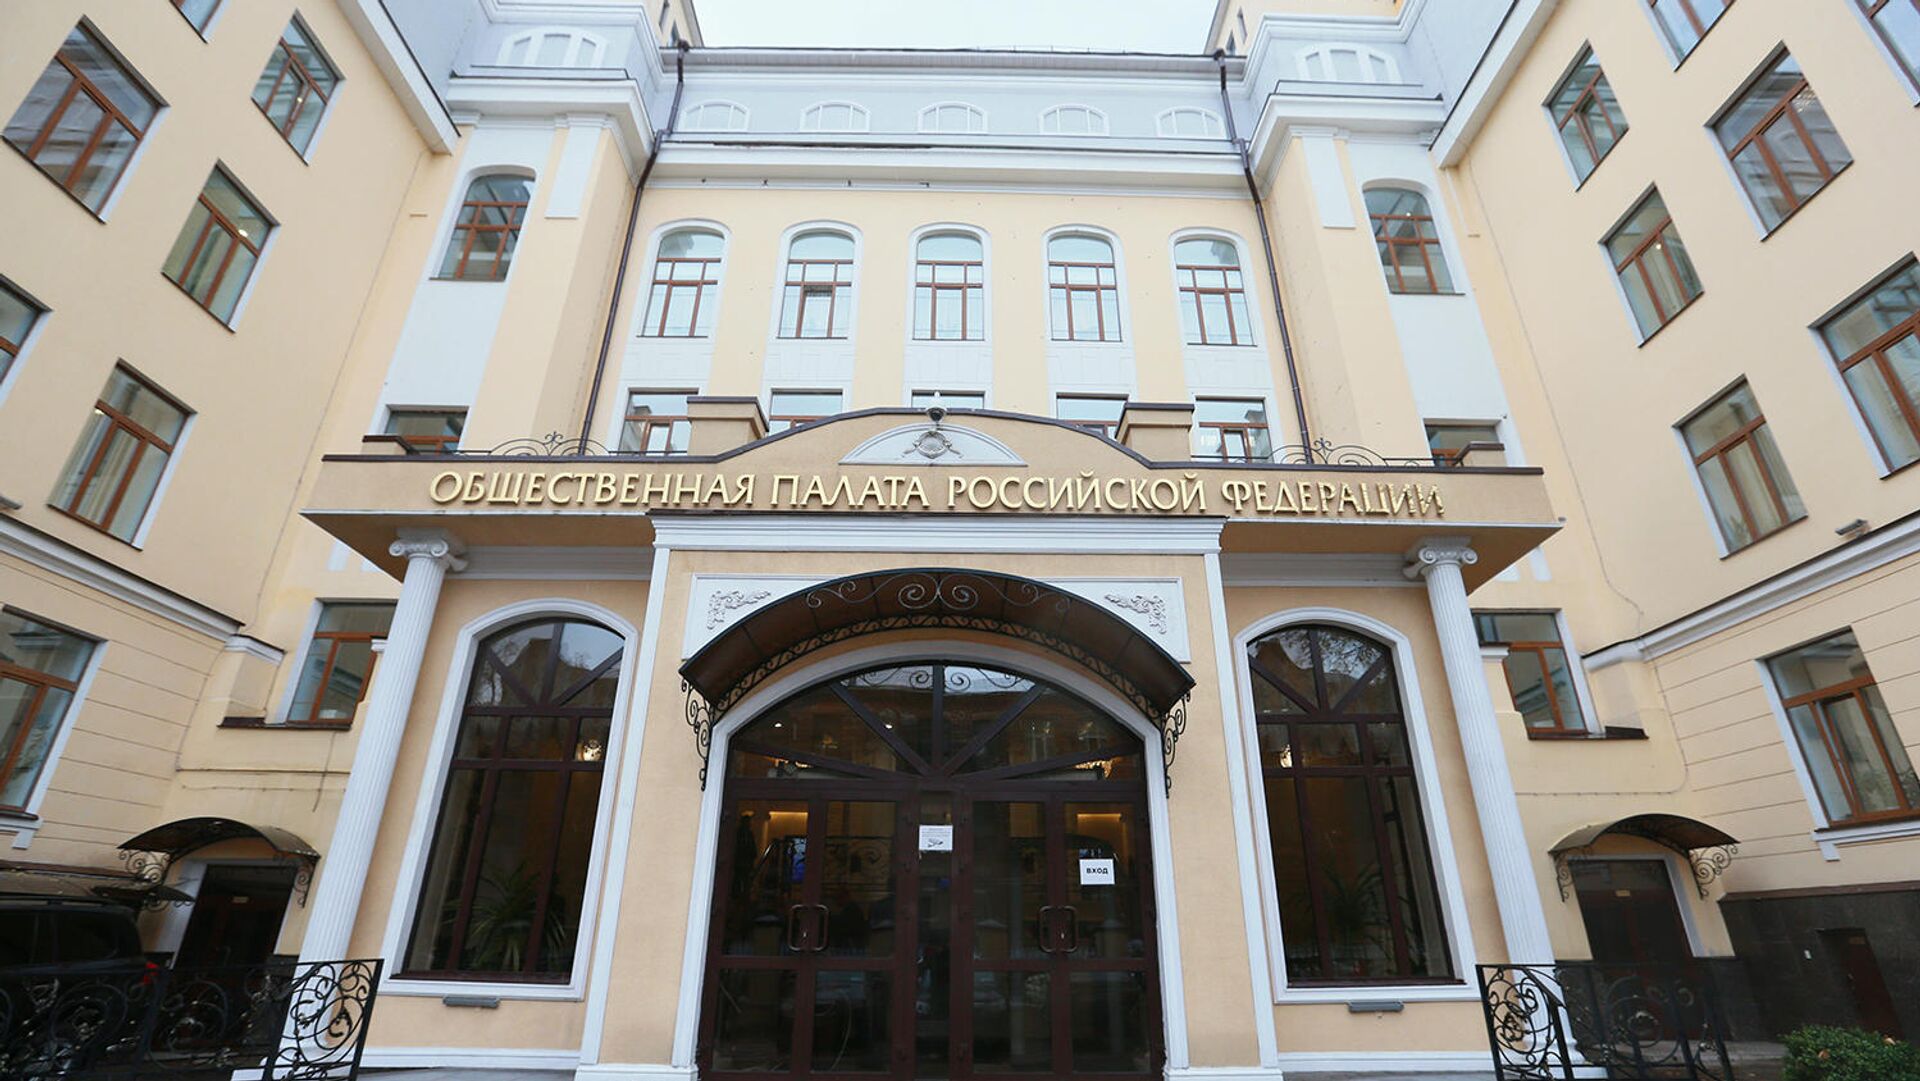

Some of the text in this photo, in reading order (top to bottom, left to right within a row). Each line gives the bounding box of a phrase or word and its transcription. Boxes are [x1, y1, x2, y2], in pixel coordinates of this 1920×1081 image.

[429, 469, 1445, 517] ОБЩЕСТВЕННАЯ ПАЛАТА РОССИЙСКОЙ ФЕДЕРАЦИИ
